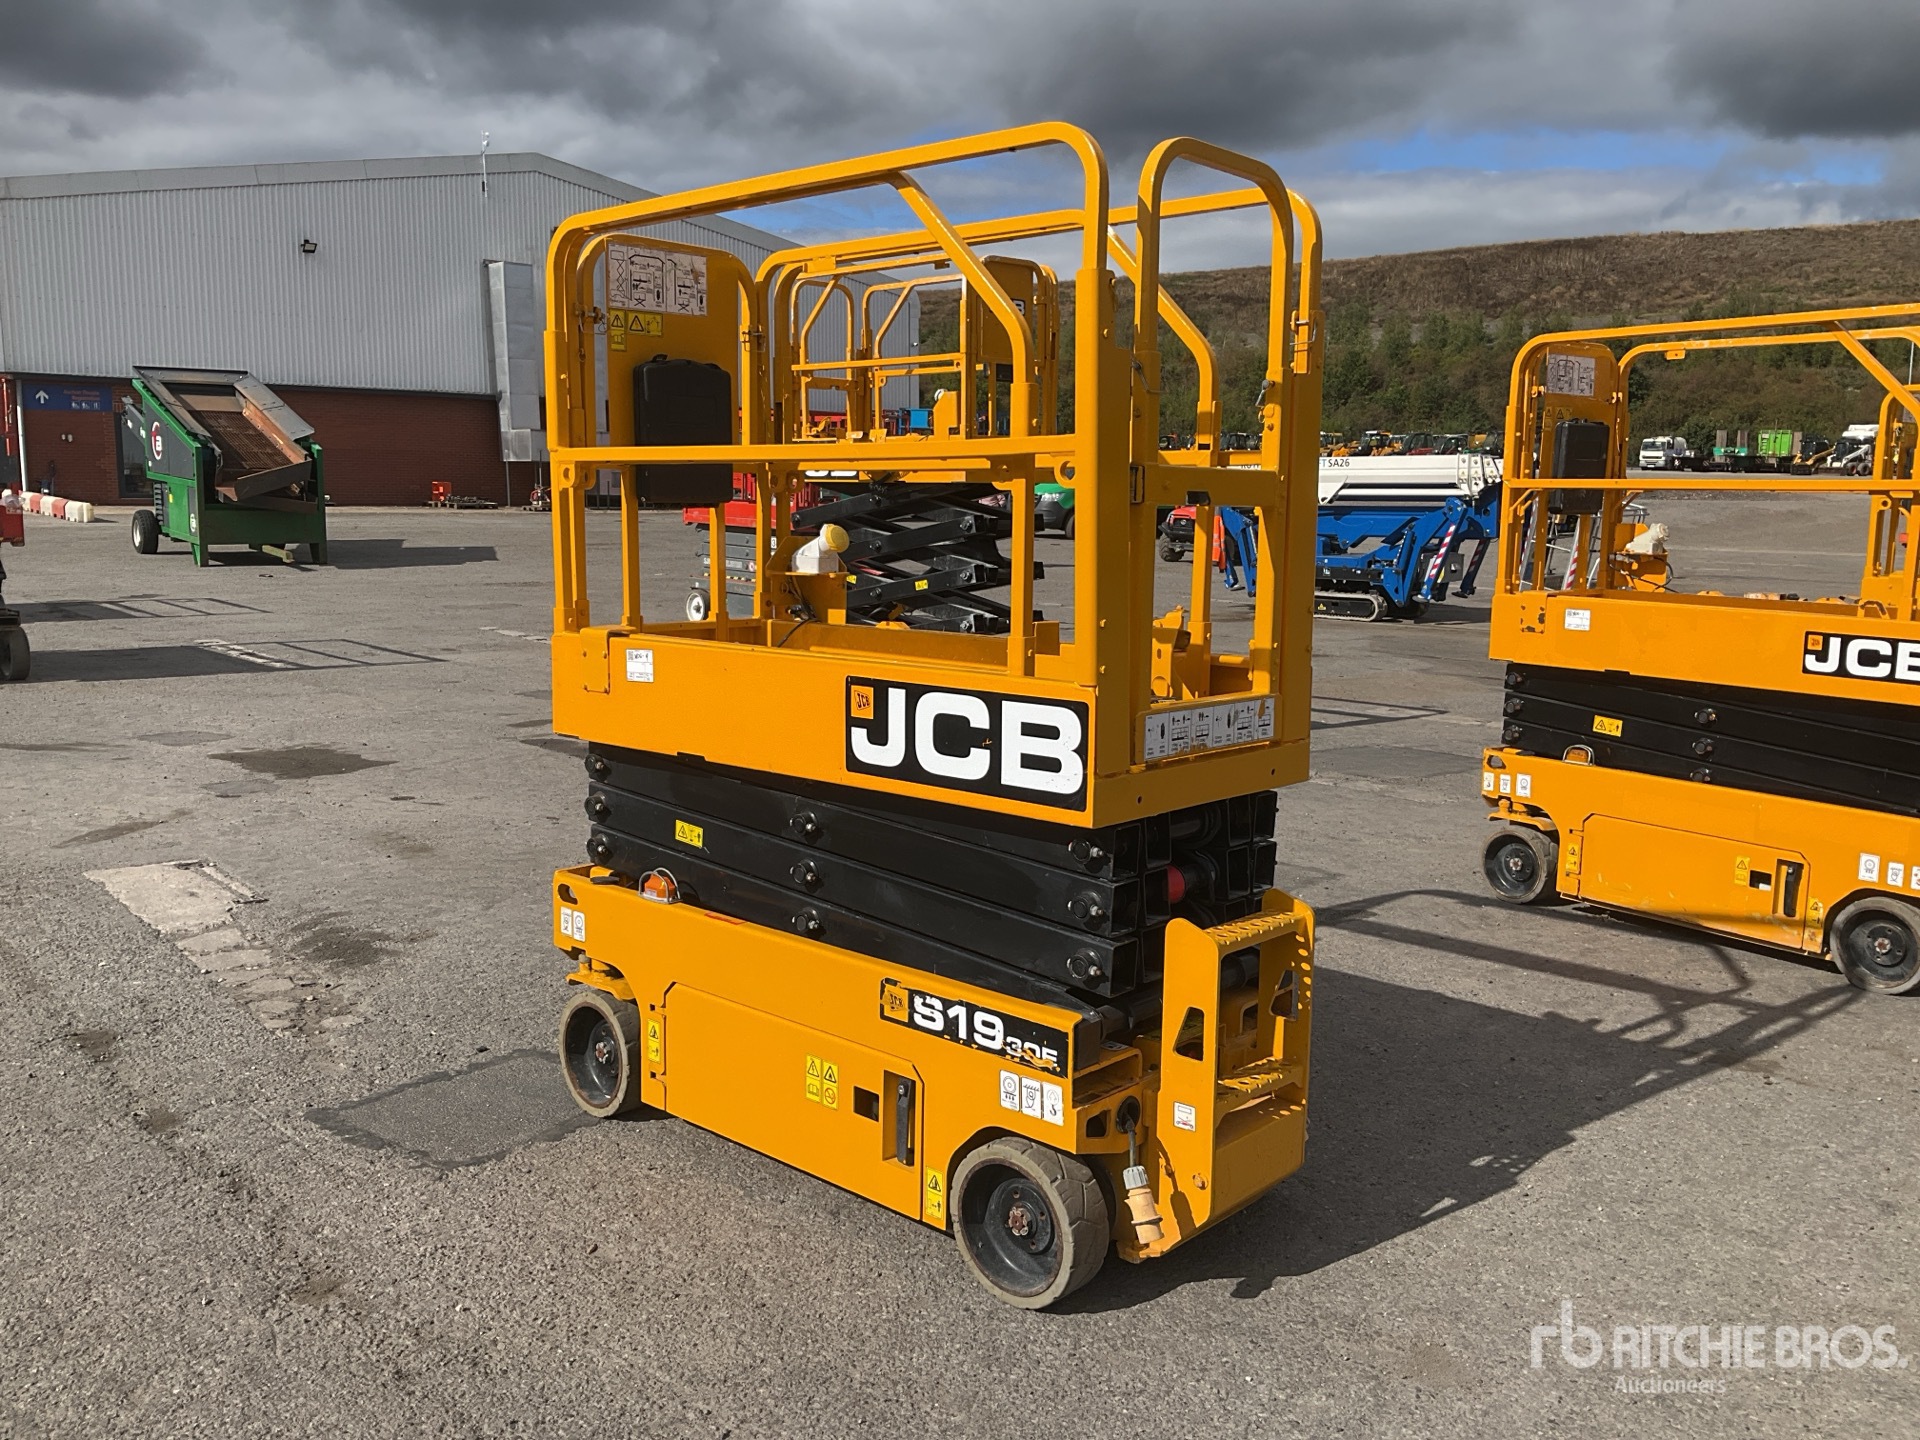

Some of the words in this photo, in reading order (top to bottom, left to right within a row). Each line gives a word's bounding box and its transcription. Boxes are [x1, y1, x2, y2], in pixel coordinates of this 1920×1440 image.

[1328, 458, 1351, 468] SA26
[856, 691, 871, 709] JCB
[850, 686, 1084, 795] JCB
